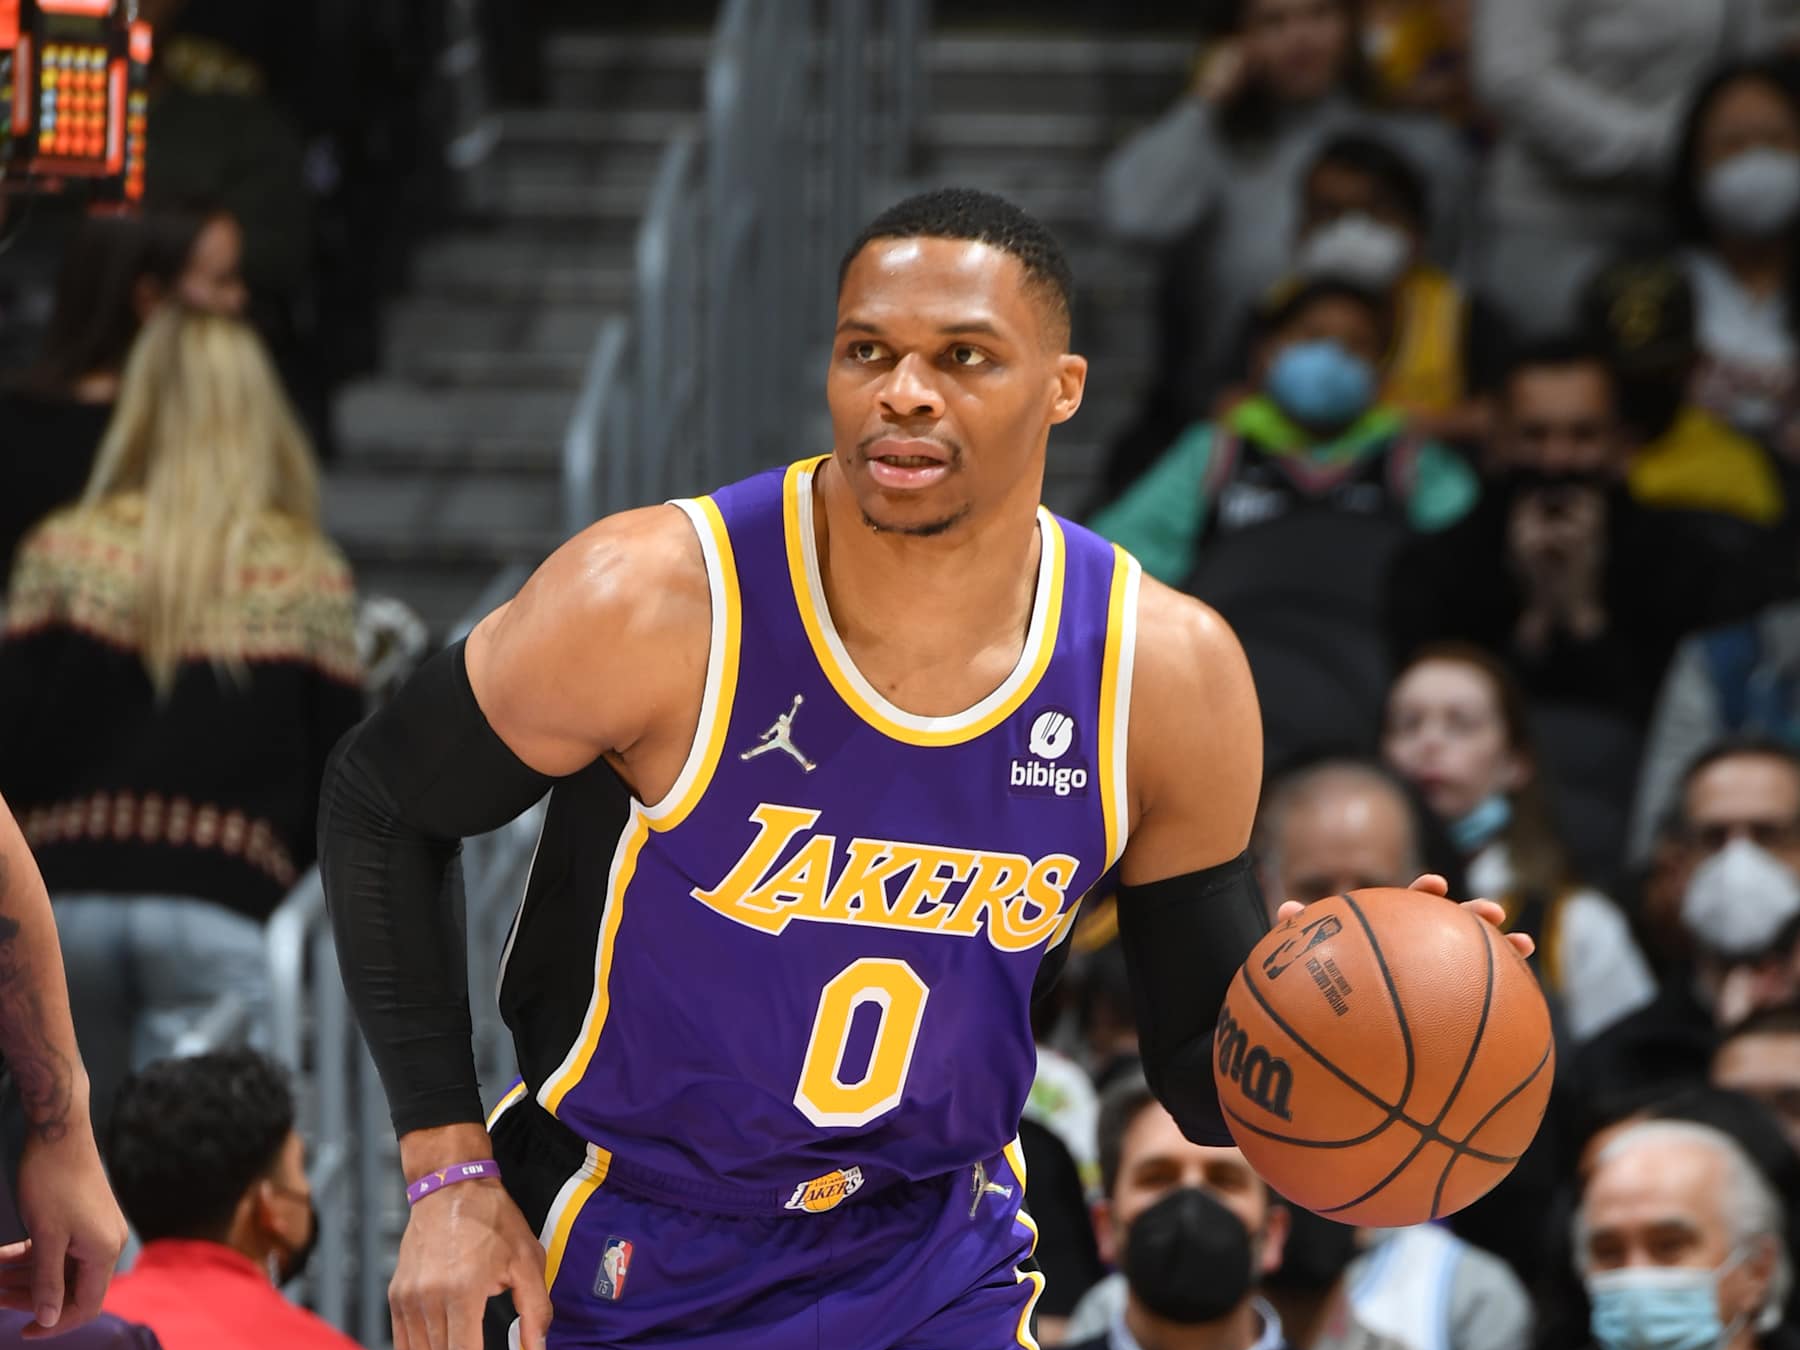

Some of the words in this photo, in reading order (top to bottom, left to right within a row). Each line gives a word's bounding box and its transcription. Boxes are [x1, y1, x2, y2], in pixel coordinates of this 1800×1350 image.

[1010, 760, 1087, 796] bibigo
[690, 803, 1080, 952] LAKERS
[793, 957, 930, 1127] 0
[791, 1176, 860, 1207] LAKERS
